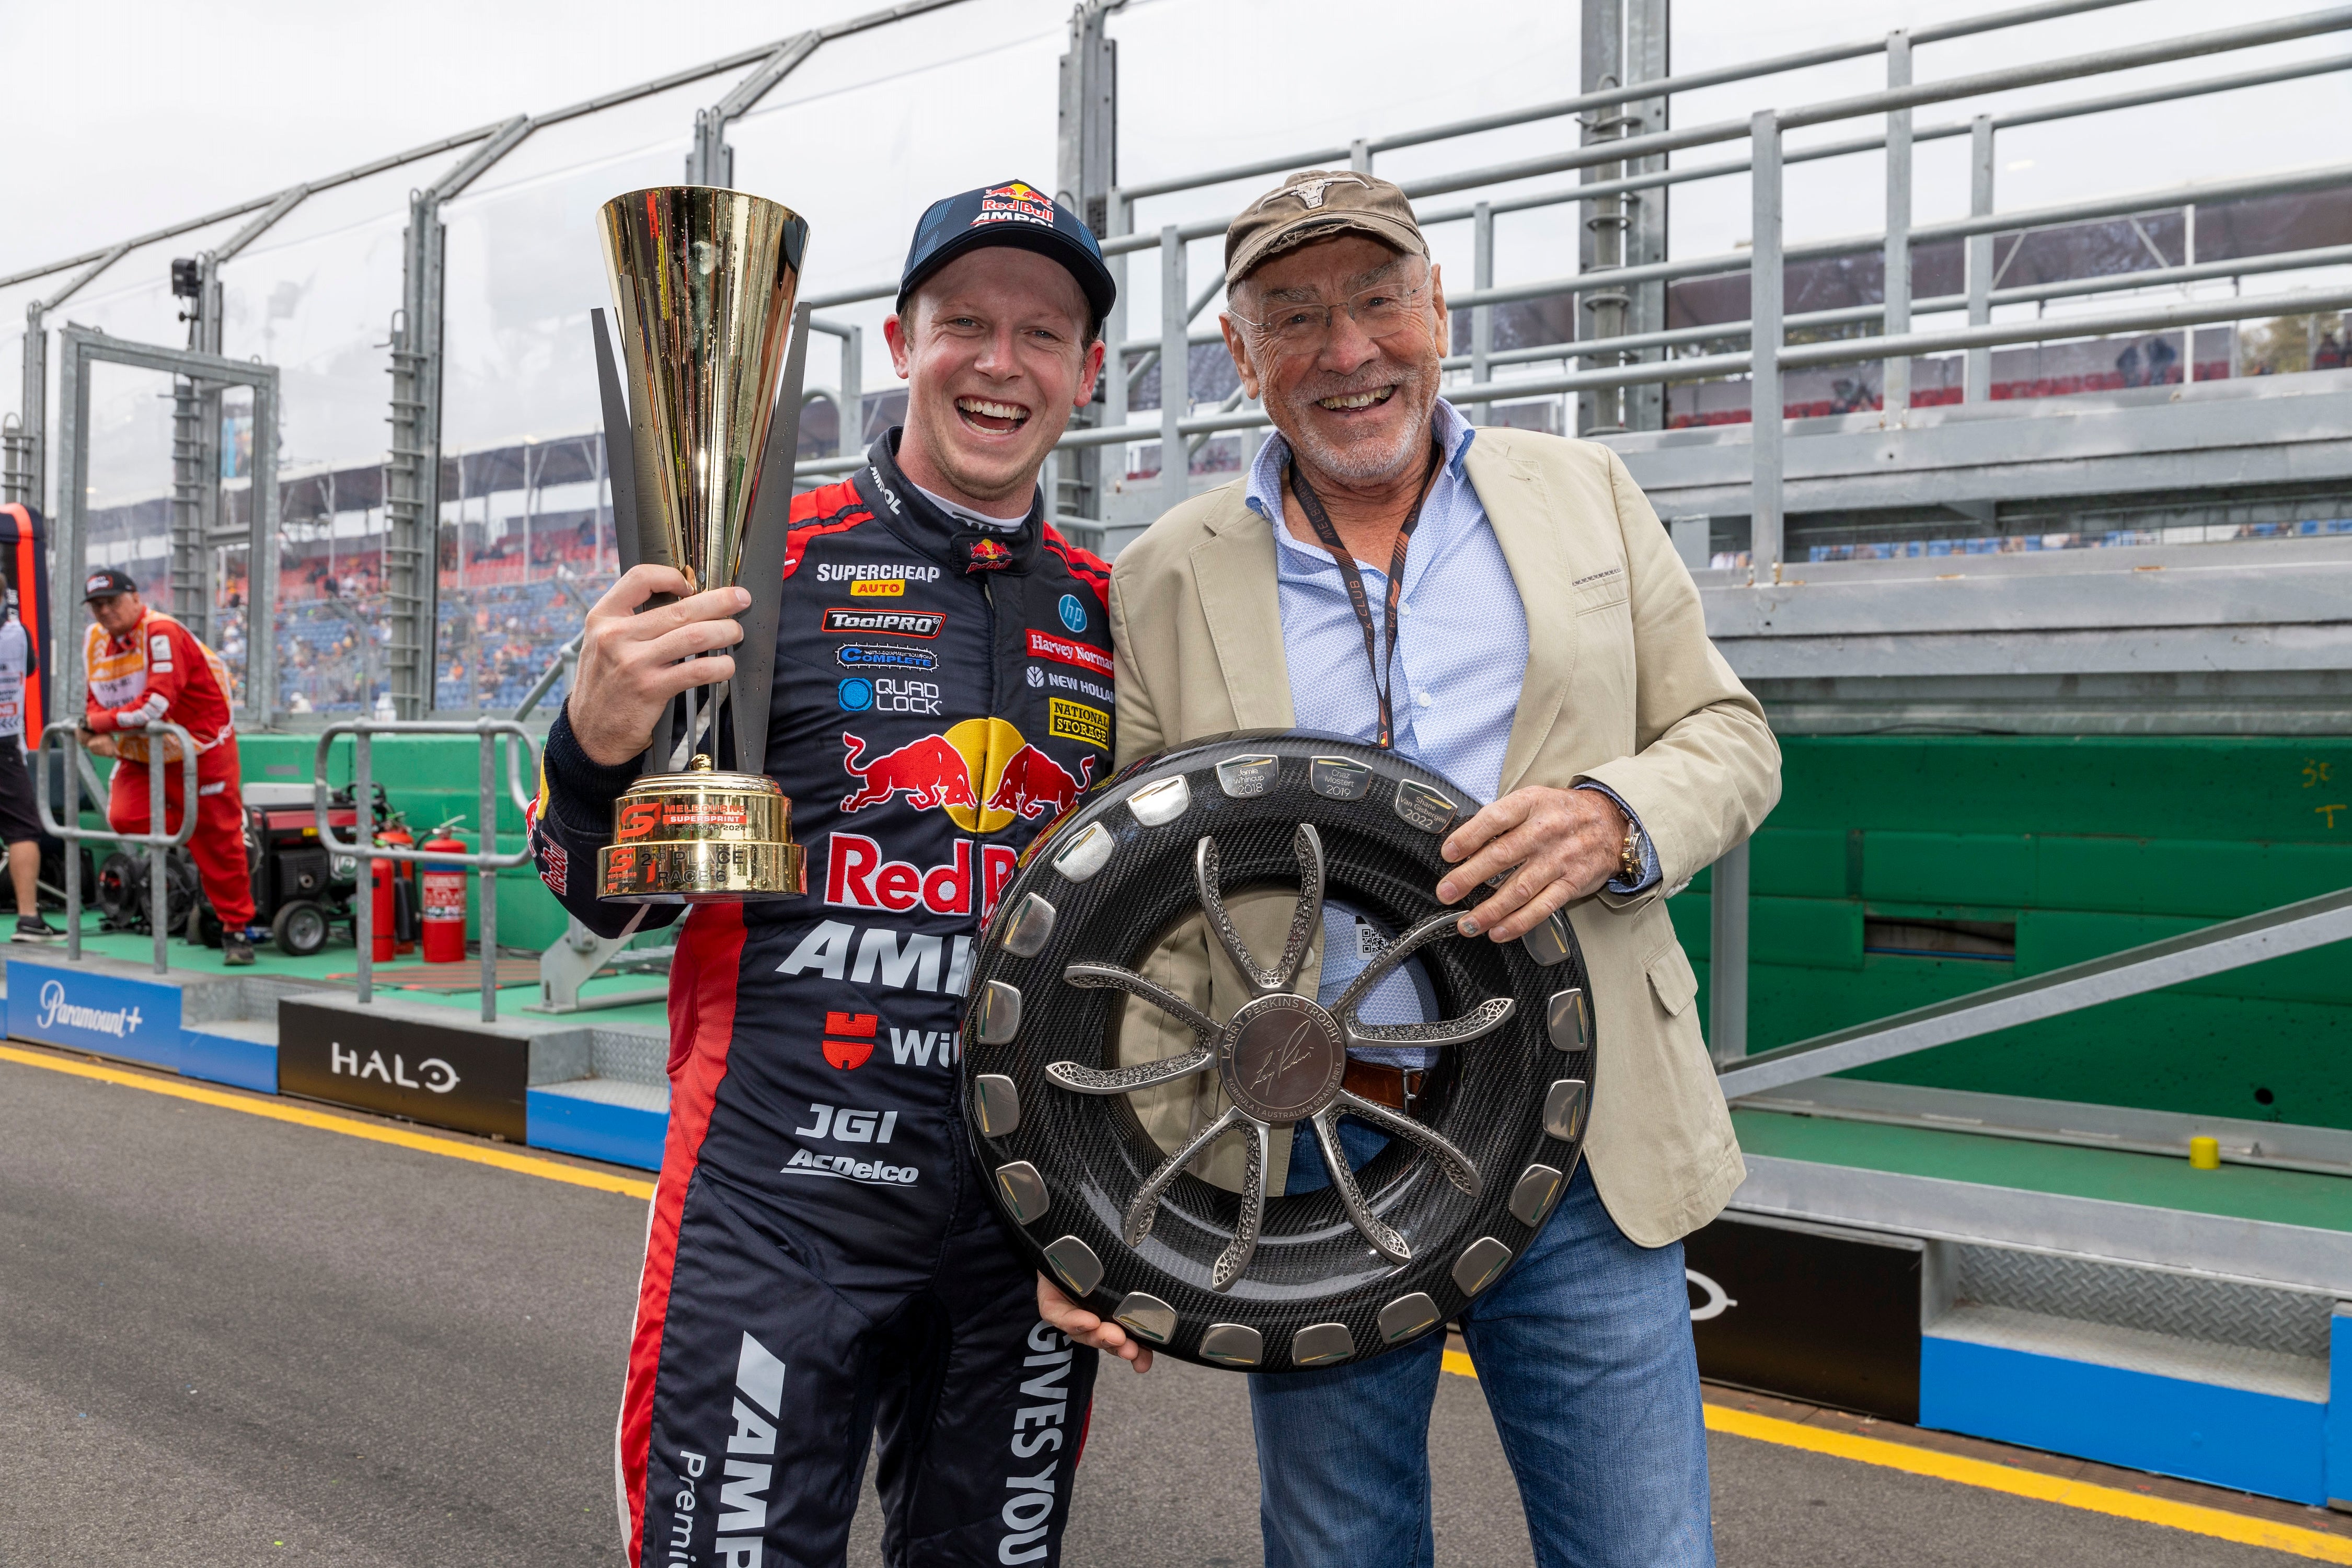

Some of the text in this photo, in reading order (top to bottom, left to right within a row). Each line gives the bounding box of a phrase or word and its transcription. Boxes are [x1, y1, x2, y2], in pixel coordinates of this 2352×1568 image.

[982, 200, 1054, 223] Red Bull
[1294, 476, 1334, 538] MELBOURNE
[816, 563, 940, 583] SUPERCHEAP
[858, 583, 900, 593] AUTO
[1350, 580, 1368, 616] CLUB
[1064, 596, 1083, 630] hp
[1031, 634, 1074, 659] Harvey
[875, 679, 939, 698] QUAD
[1048, 673, 1115, 704] NEW HOLLAN
[877, 695, 942, 715] LOCK
[1054, 702, 1108, 728] NATIONAL
[1056, 719, 1107, 742] STORAGE
[1233, 775, 1265, 784] Whincup
[1238, 768, 1259, 776] Jamie
[1324, 776, 1354, 787] Mostert
[1238, 782, 1264, 795] 2018
[1326, 785, 1351, 797] 2019
[664, 805, 746, 813] MELBOURNE
[1400, 796, 1447, 824] Van Gisbergen
[1415, 797, 1436, 811] Shane
[1404, 809, 1433, 829] 2022
[540, 829, 568, 896] Red Bull
[641, 850, 744, 867] 2ND PLACE
[658, 870, 727, 883] RACE 6
[824, 832, 973, 916] Red
[37, 979, 143, 1039] Paramount+
[1222, 997, 1342, 1059] LARRY PERKINS TROPHY
[331, 1041, 461, 1093] HALO
[1227, 1078, 1255, 1112] FORMULA
[1261, 1104, 1313, 1119] AUSTRALIAN
[1313, 1081, 1335, 1106] GRAND
[1332, 1062, 1342, 1081] PRIX
[795, 1103, 898, 1143] JGI
[998, 1319, 1074, 1565] GIVES YOU
[714, 1396, 778, 1568] AMP
[668, 1450, 707, 1568] Premi
